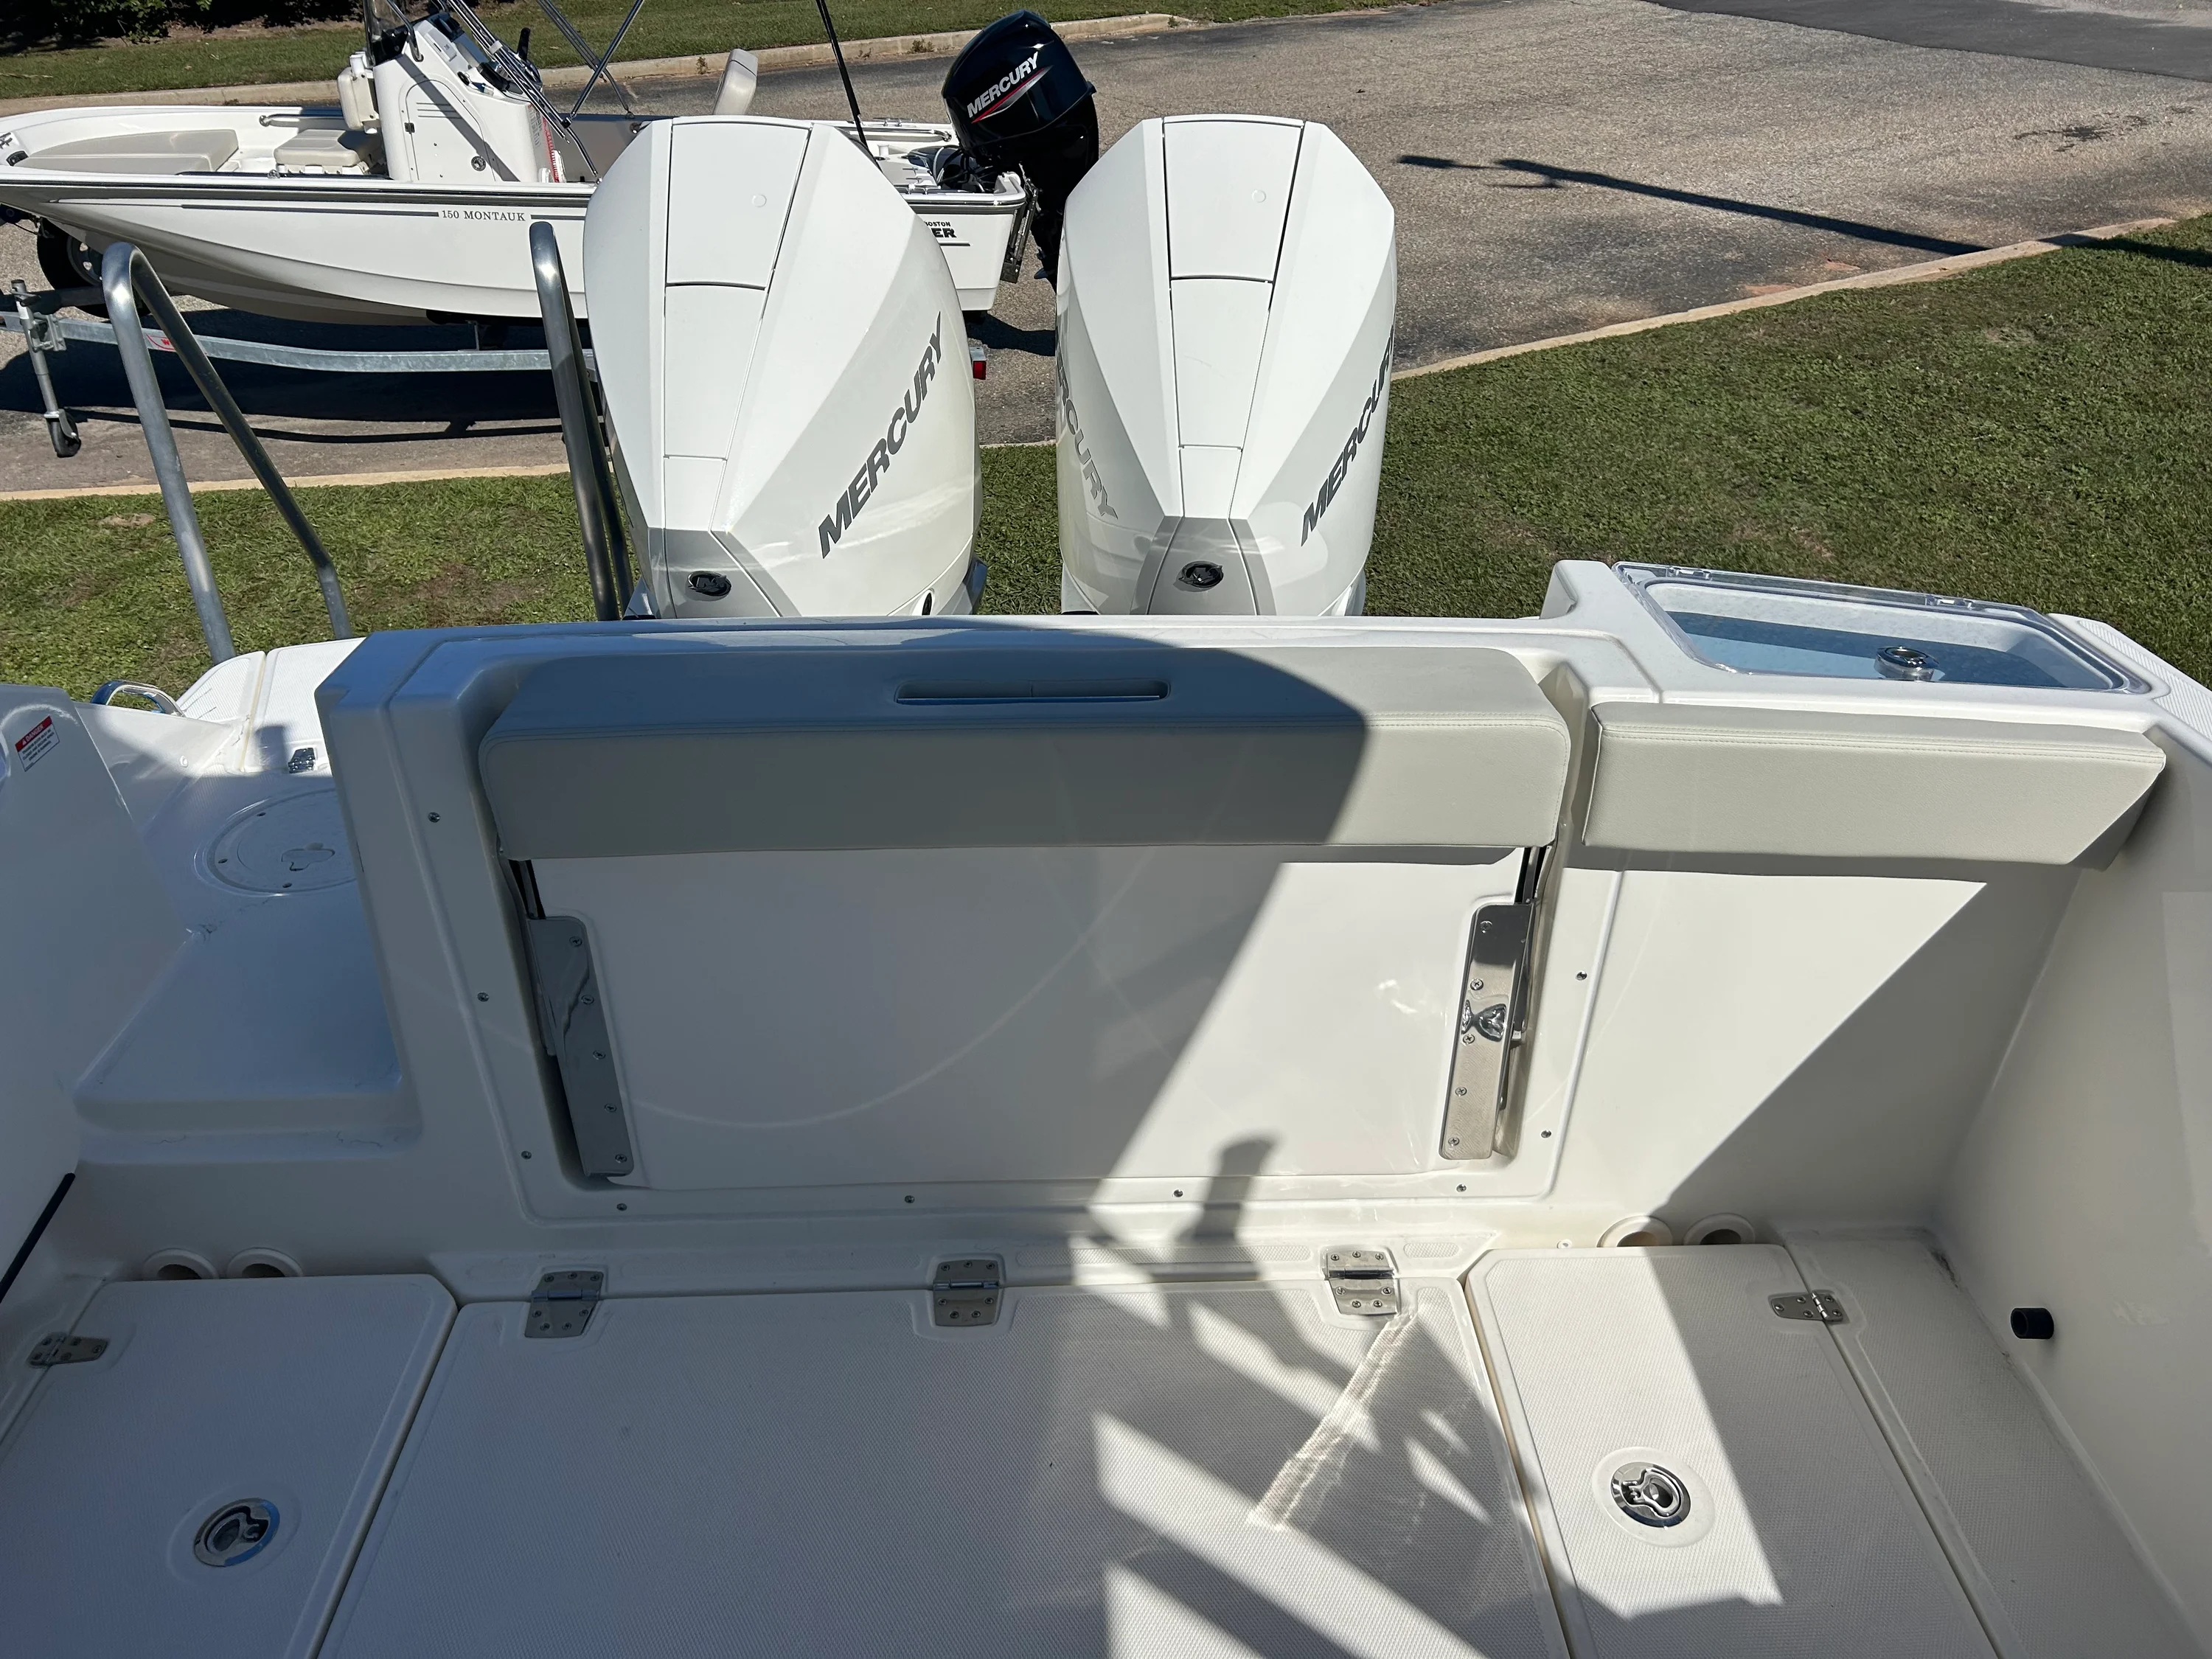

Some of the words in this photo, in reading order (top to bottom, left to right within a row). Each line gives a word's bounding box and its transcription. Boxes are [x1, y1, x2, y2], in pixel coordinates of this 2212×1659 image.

[967, 51, 1038, 118] MERCURY
[442, 210, 459, 219] 150
[463, 210, 526, 221] MONTAUK
[818, 310, 942, 559] MERCURY
[25, 723, 44, 742] DANGER
